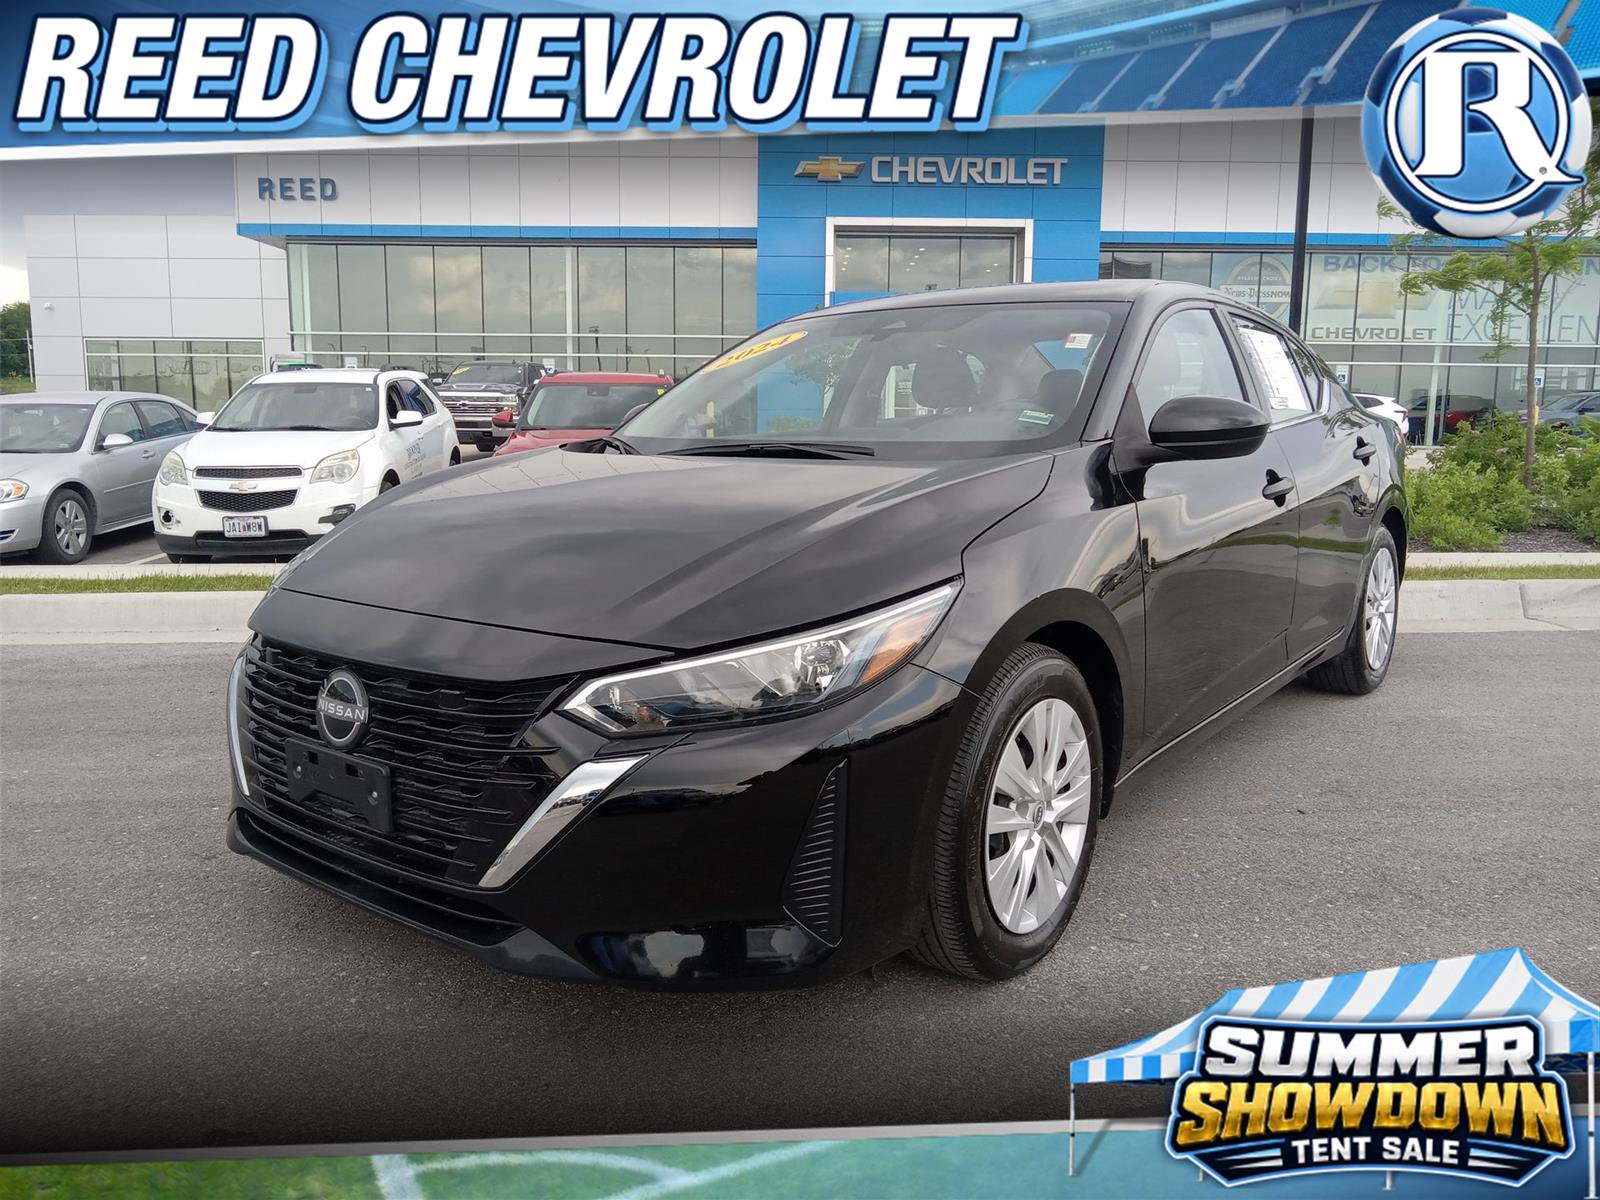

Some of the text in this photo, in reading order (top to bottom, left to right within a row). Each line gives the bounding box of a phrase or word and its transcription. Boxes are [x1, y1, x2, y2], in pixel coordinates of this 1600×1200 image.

[871, 156, 1068, 186] CHEVROLET
[258, 177, 338, 201] REED
[1323, 256, 1396, 272] BACK
[1311, 327, 1437, 341] CHEVROLET
[317, 699, 365, 721] NISSAN
